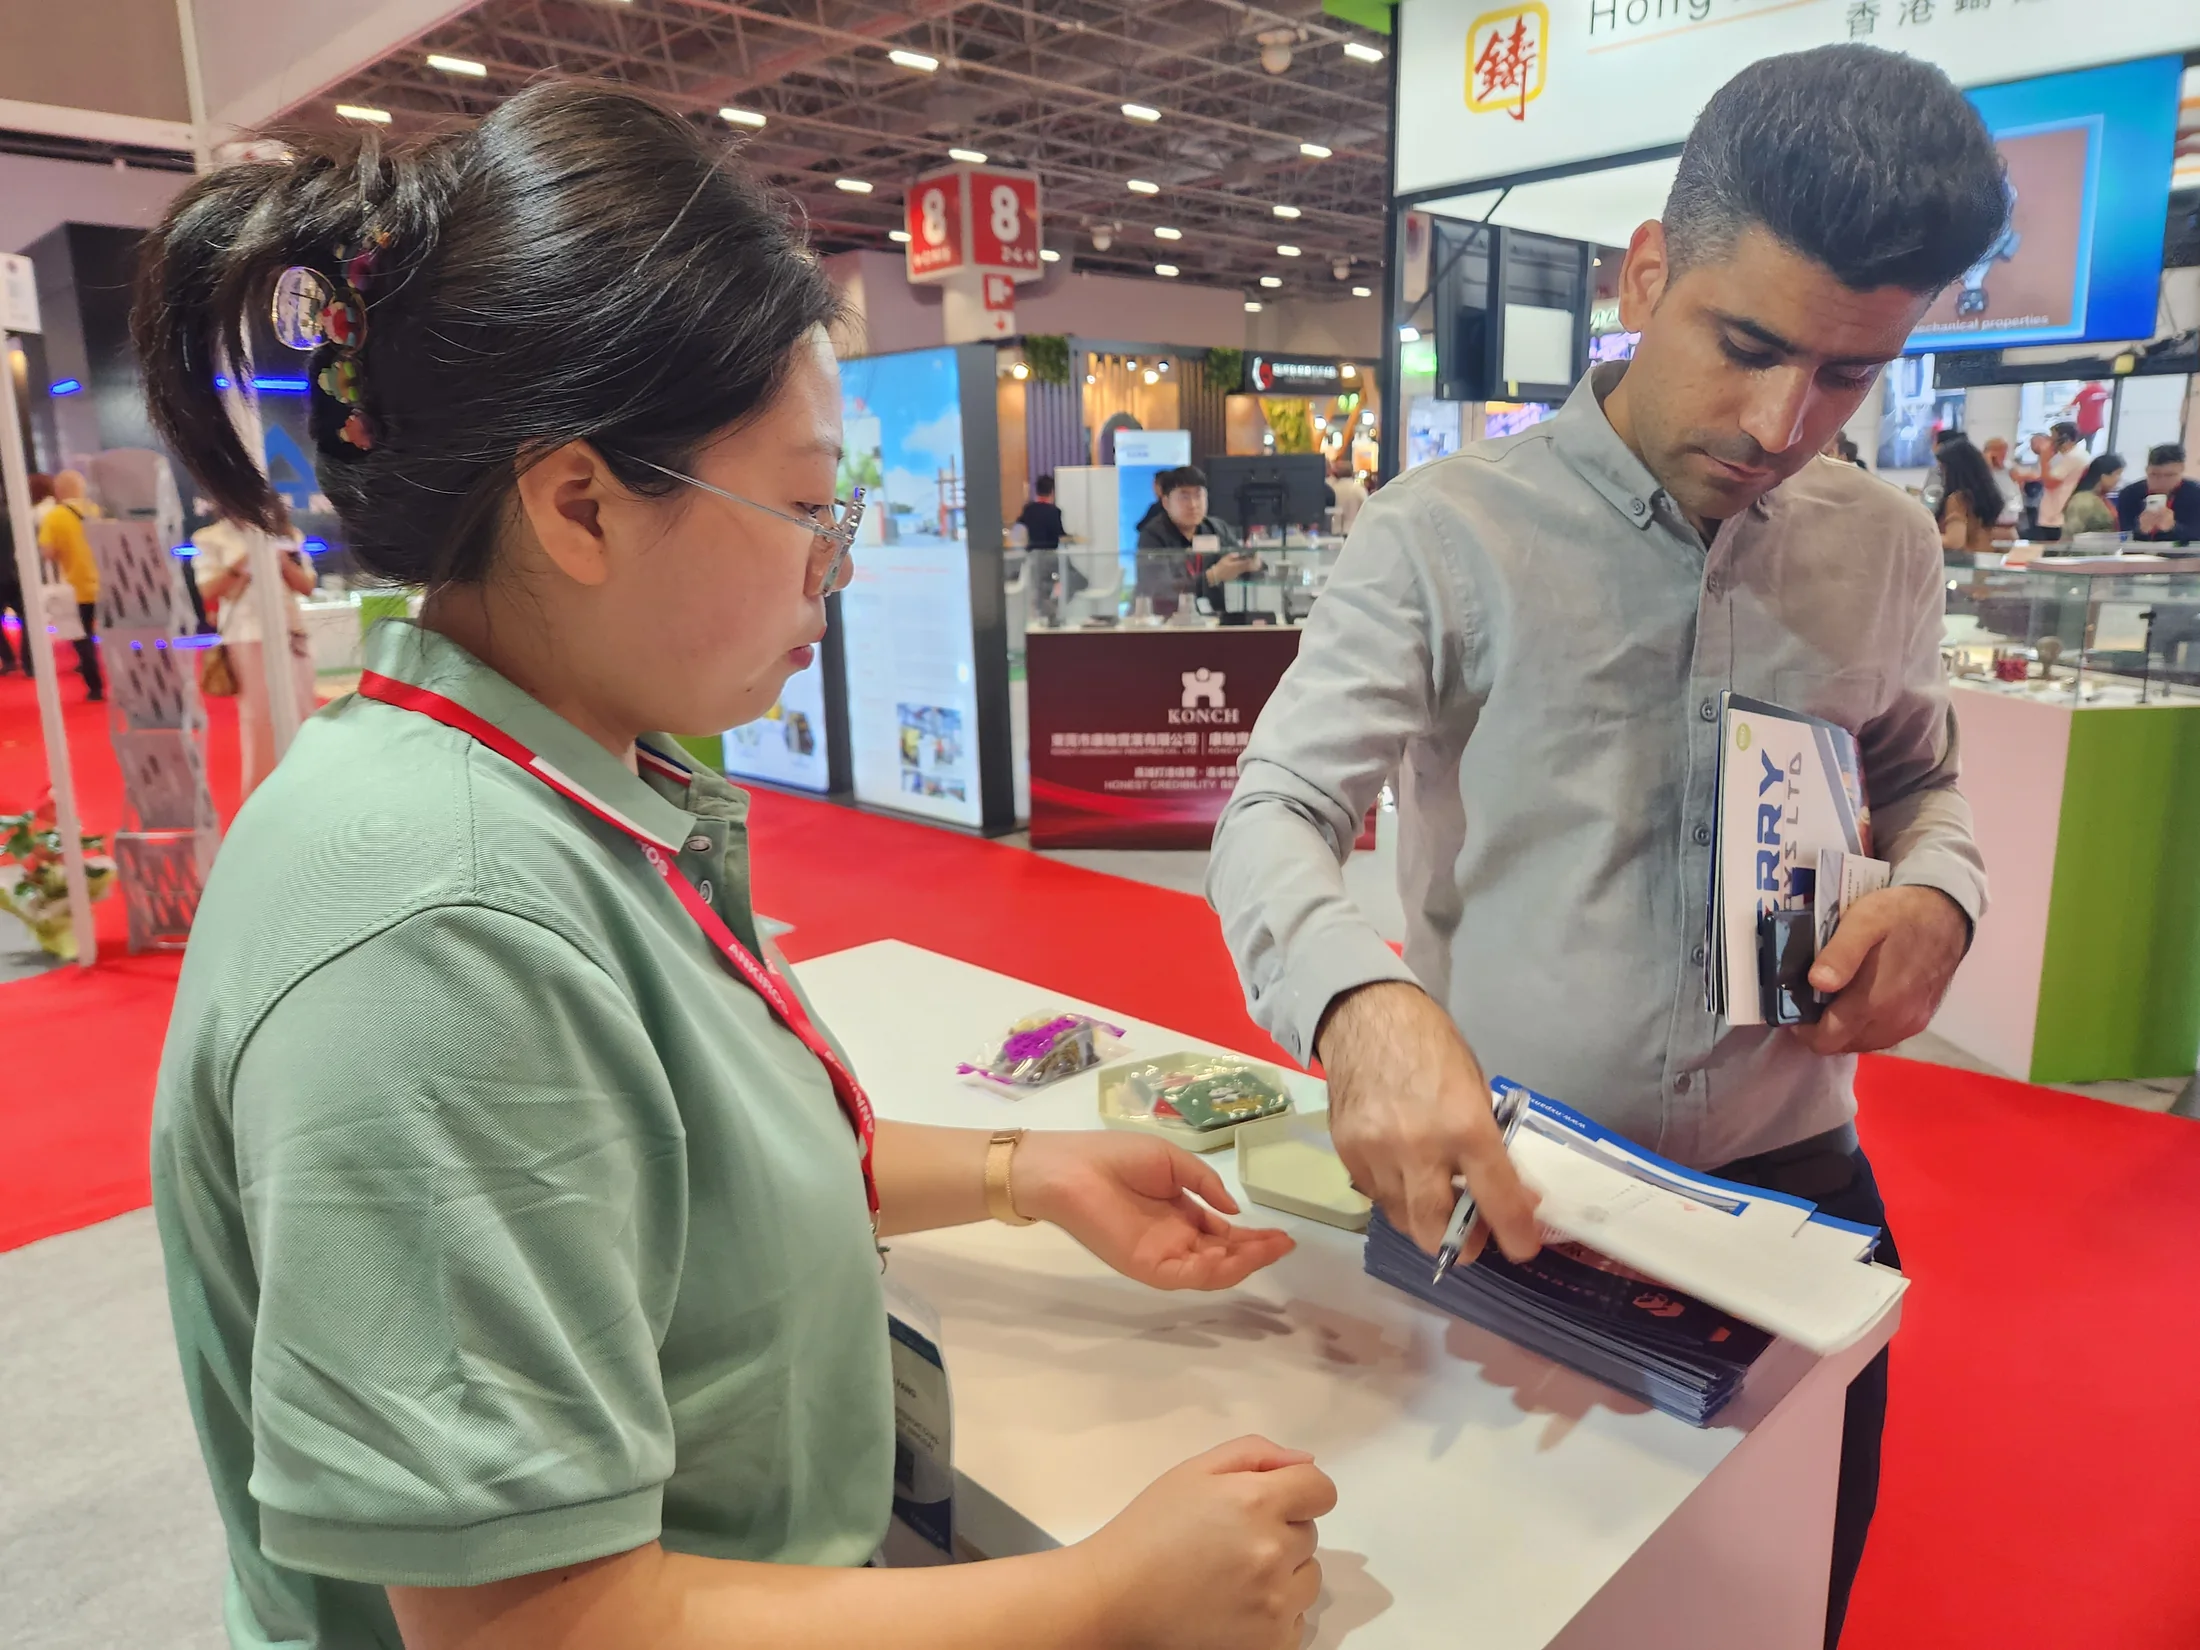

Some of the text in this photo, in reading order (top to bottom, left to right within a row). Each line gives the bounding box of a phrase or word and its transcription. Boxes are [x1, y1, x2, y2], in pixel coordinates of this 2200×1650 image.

[922, 188, 946, 246] 8
[990, 185, 1020, 242] 8
[1912, 313, 2050, 333] echanical properties
[1168, 709, 1240, 724] KONCH
[1786, 752, 1802, 825] LTD
[728, 943, 789, 1015] ANKIROS
